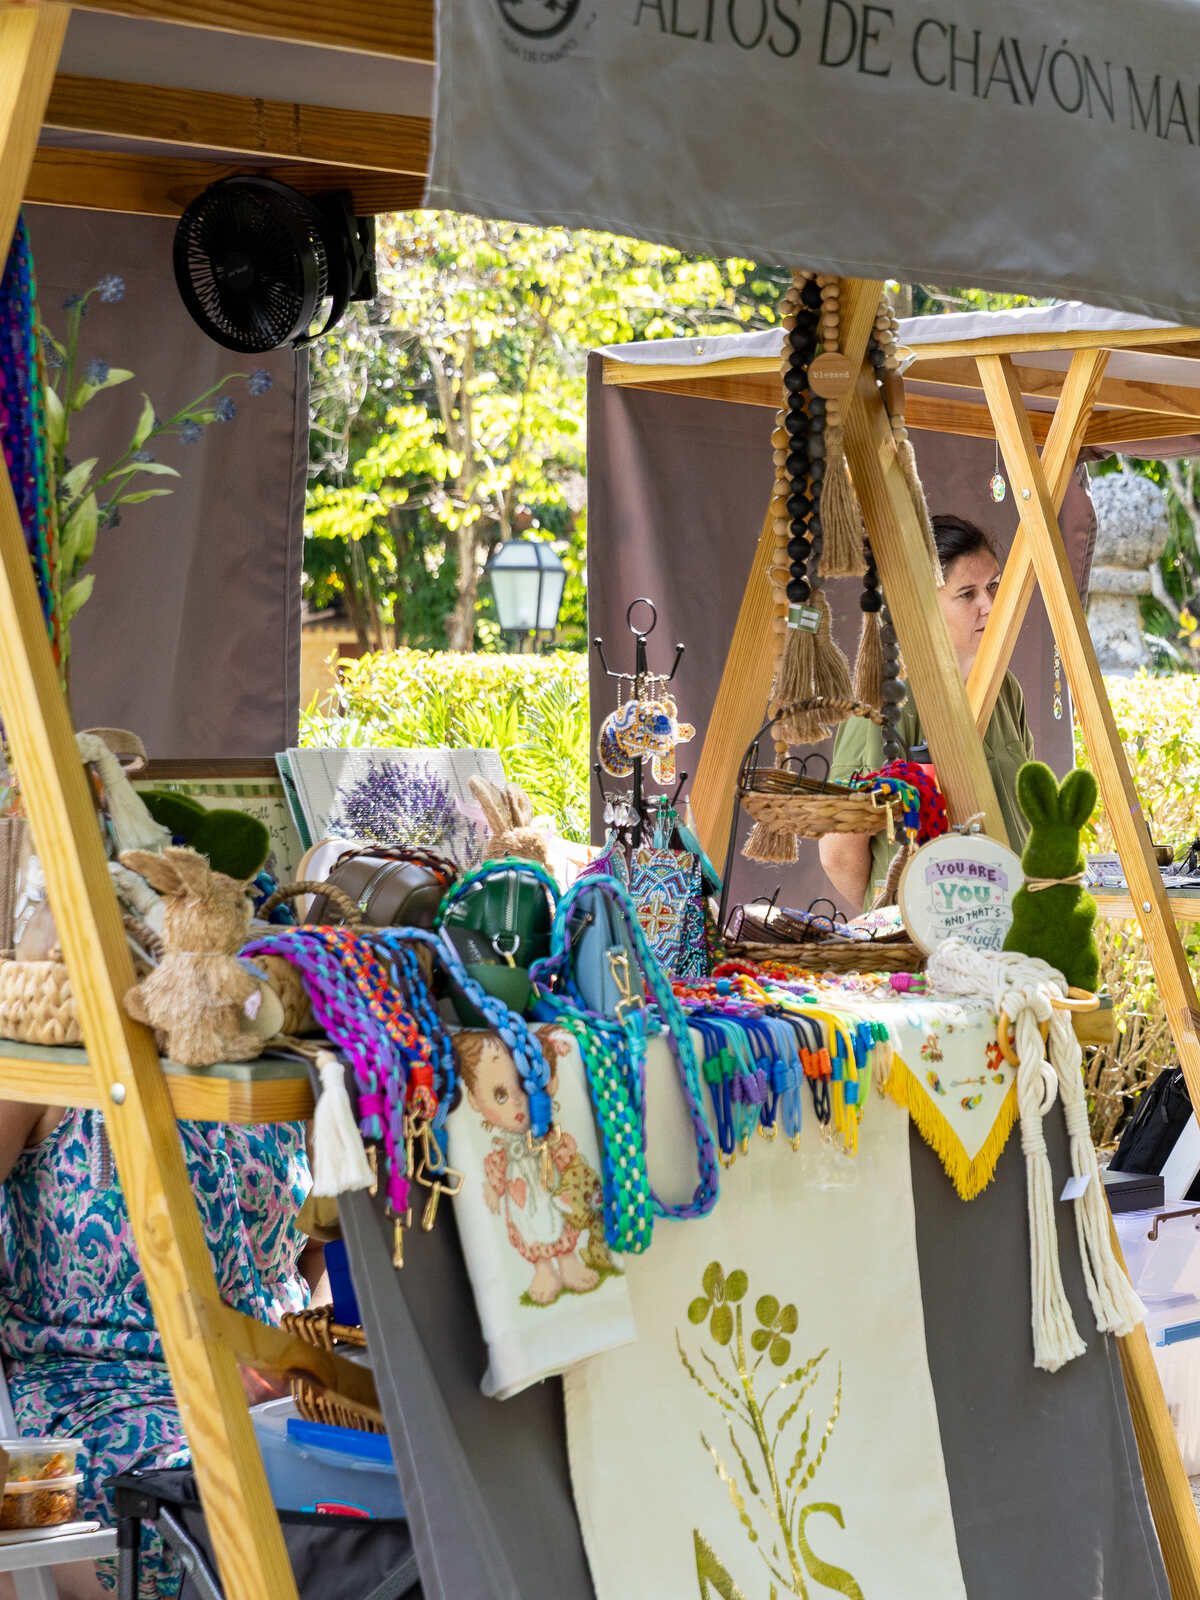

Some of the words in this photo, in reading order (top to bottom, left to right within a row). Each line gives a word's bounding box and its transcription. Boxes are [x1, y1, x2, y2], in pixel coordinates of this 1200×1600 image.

[818, 0, 895, 78] DE
[912, 18, 1117, 124] CHAVÓN
[936, 862, 965, 876] YOU
[968, 863, 997, 882] ARE
[938, 882, 991, 909] YOU
[944, 914, 965, 927] AND
[965, 905, 1001, 921] THAT'S
